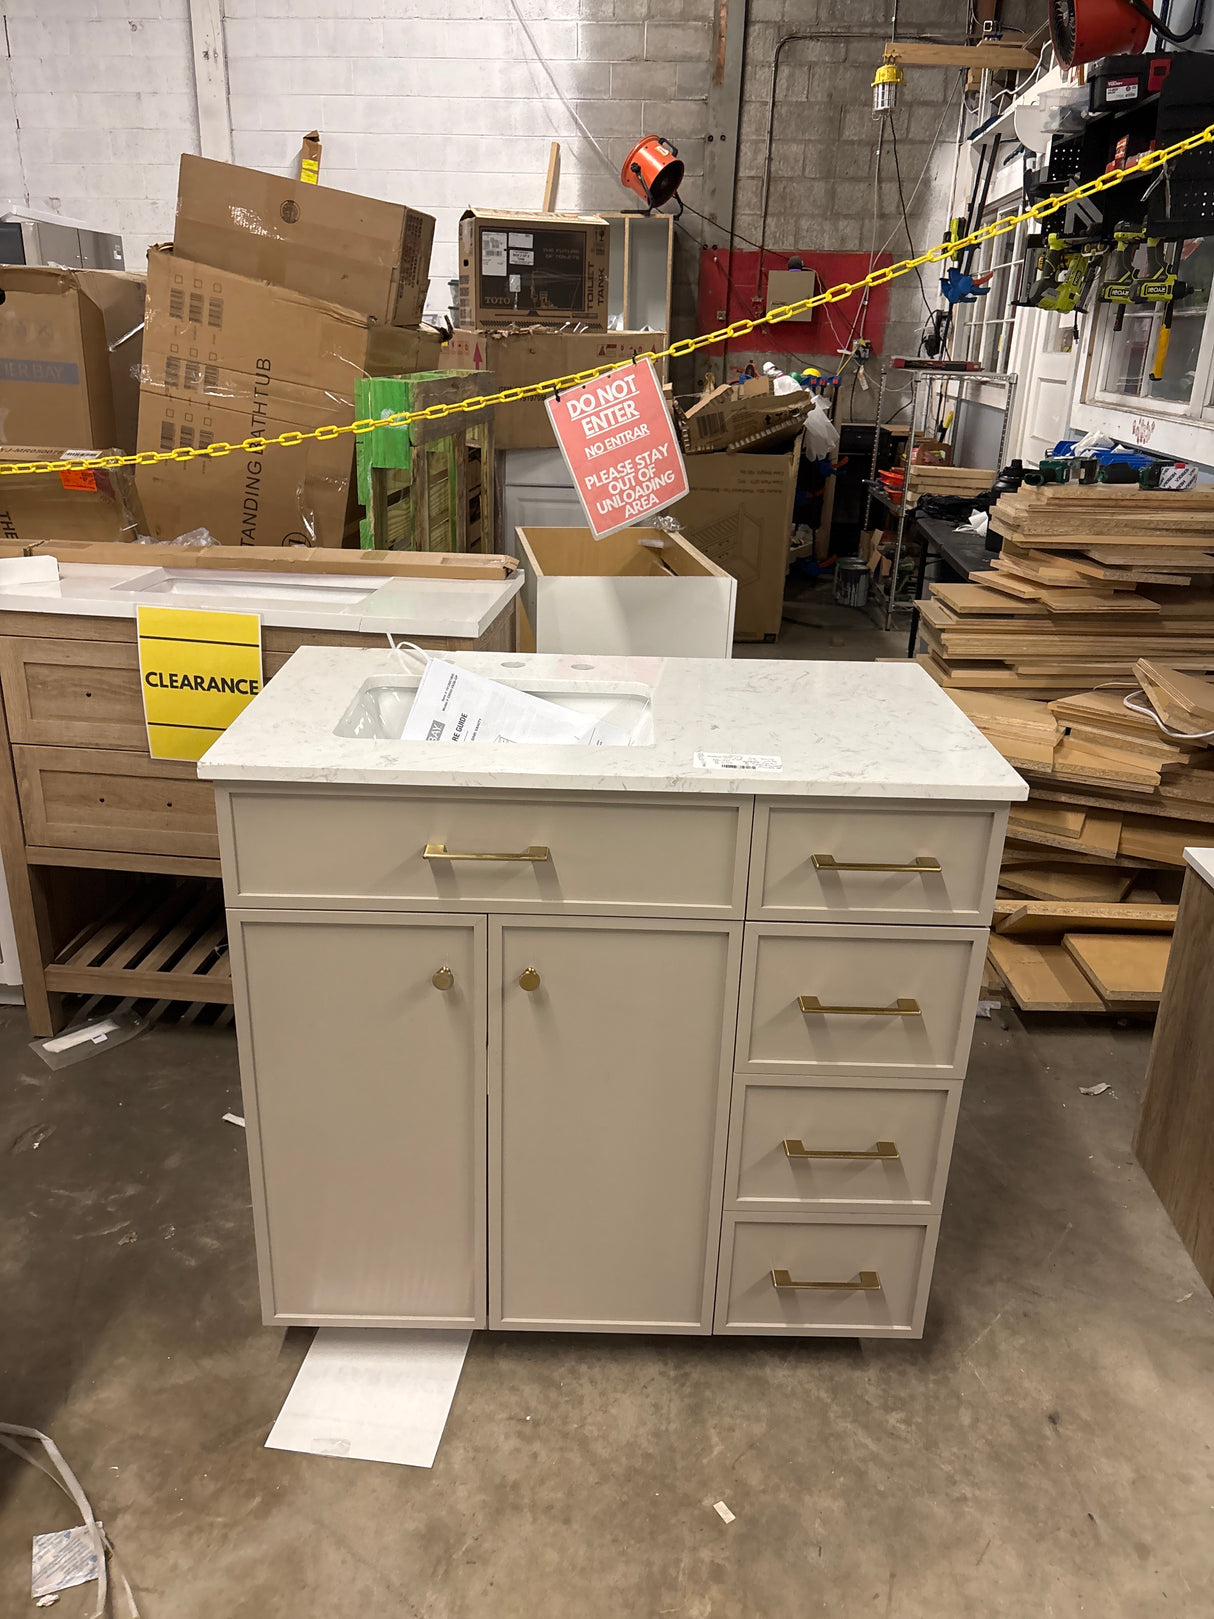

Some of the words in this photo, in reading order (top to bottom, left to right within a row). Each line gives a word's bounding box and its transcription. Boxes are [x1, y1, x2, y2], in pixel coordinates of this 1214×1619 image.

[484, 296, 510, 305] TOTO
[587, 261, 595, 311] TOILET
[597, 268, 605, 306] TANK
[249, 358, 272, 456] BATHTUB
[566, 394, 596, 418] DO
[596, 374, 639, 406] NOT
[580, 400, 640, 437] ENTER
[584, 443, 604, 459] NO
[606, 423, 650, 451] ENTRAR
[584, 459, 635, 490] PLEASE
[635, 443, 669, 468] STAY
[608, 473, 636, 495] OUT
[638, 464, 657, 482] OF
[596, 470, 675, 515] UNLOADING
[624, 495, 659, 519] AREA
[0, 511, 19, 539] THE
[145, 671, 259, 696] CLEARANCE
[429, 723, 443, 741] BAY
[455, 712, 468, 733] GUIDE
